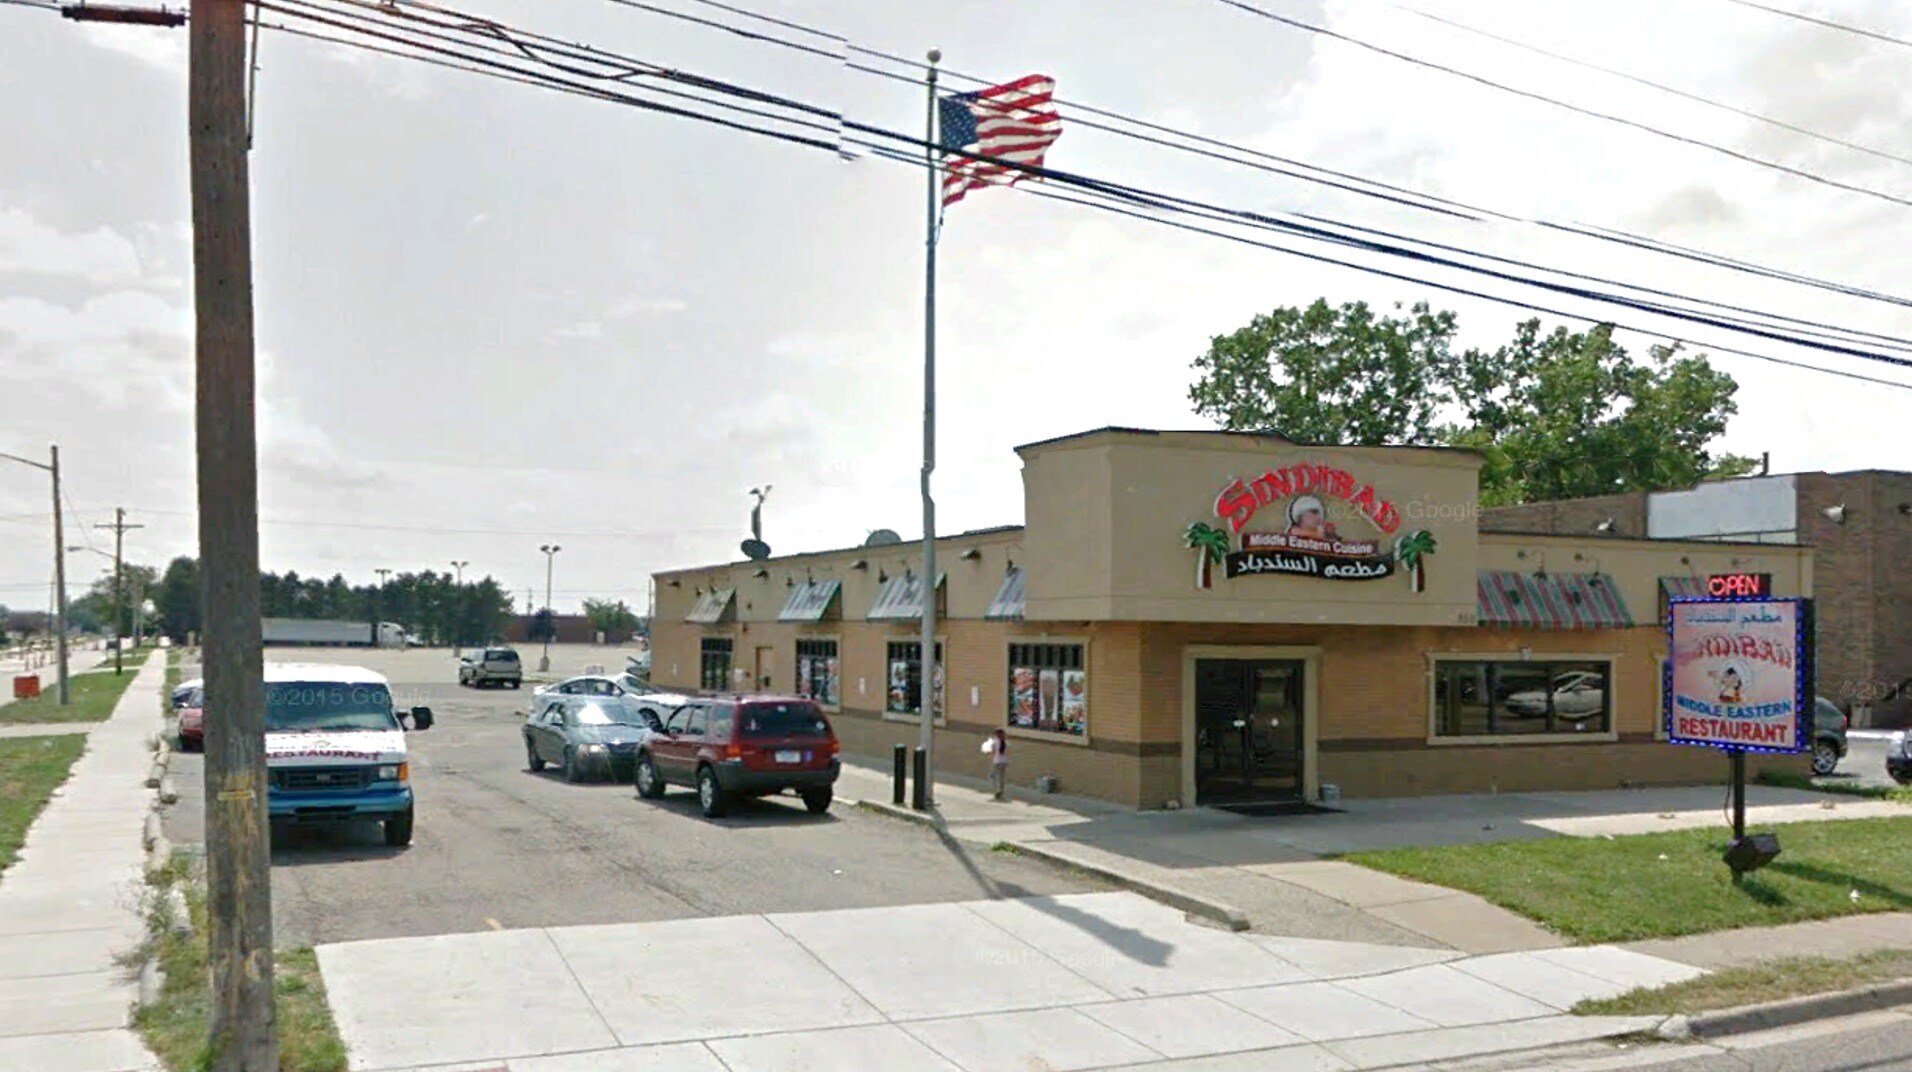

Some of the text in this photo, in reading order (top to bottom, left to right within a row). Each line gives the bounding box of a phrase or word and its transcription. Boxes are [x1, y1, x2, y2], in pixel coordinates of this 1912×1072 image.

[1214, 461, 1401, 534] SINDIBAD
[1249, 533, 1374, 554] Middle Eastern Cuisine
[1237, 554, 1388, 577] مطعم السندباد
[1708, 575, 1760, 596] OPEN
[1676, 694, 1792, 719] MIDDLE EASTERN
[1679, 717, 1788, 743] RESTAURANT
[266, 750, 381, 761] ESTAURANT
